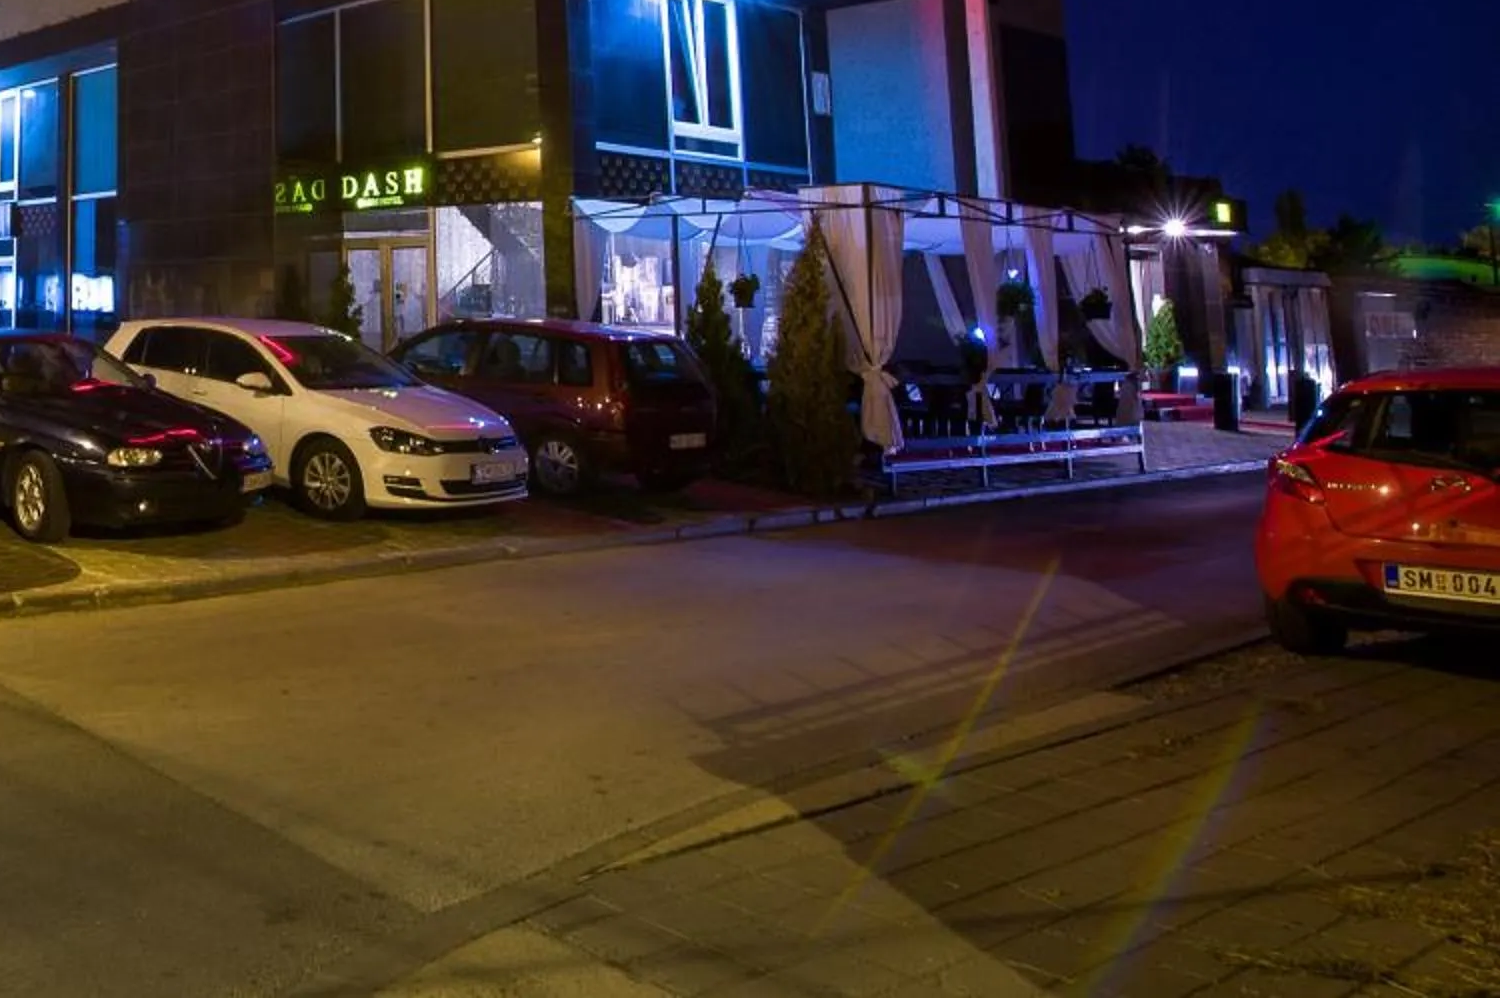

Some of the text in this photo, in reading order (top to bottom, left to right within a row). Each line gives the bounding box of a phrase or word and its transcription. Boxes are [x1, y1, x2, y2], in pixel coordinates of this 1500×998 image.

[341, 167, 424, 199] DASH
[1403, 570, 1497, 595] SM 004
